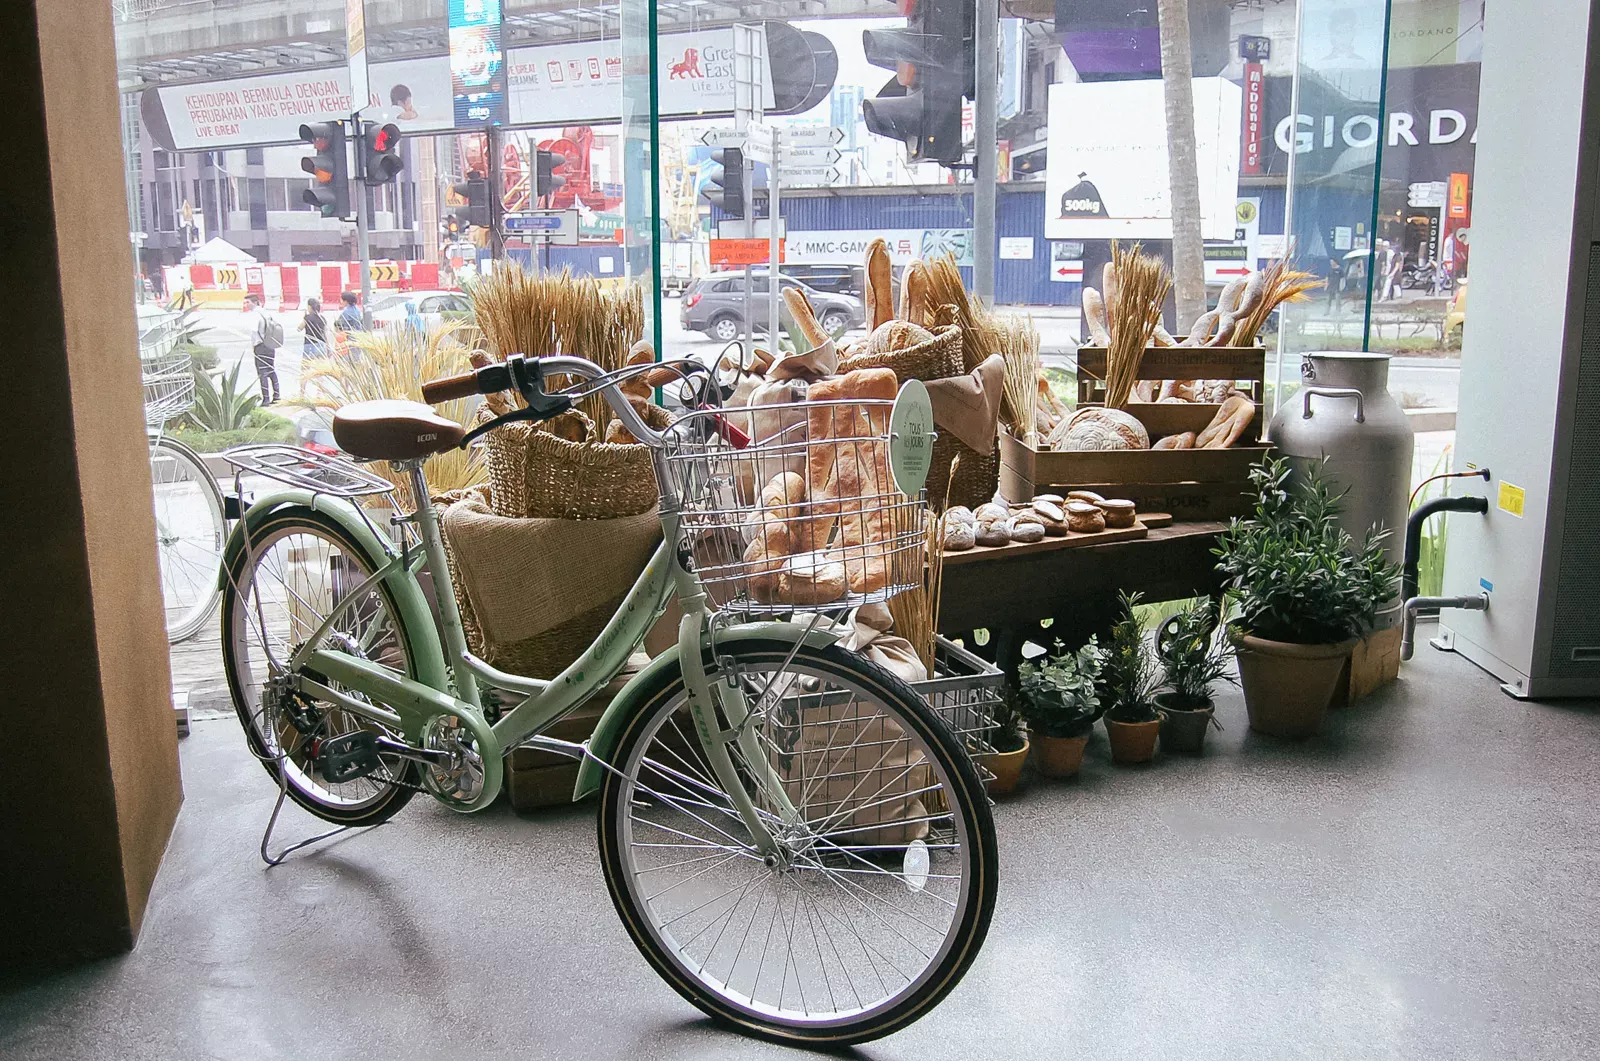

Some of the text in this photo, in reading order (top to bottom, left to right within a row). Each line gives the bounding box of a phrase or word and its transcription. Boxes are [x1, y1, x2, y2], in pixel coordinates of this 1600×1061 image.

[1392, 26, 1454, 39] IORDANO
[703, 45, 735, 62] Grea
[704, 62, 735, 78] East
[691, 80, 712, 92] Life
[716, 80, 725, 90] is
[185, 80, 340, 109] KEHIDUPAN BERMULA DENGAN
[190, 106, 249, 124] PERUBAHAN
[251, 102, 278, 119] YANG
[280, 100, 316, 116] PENUH
[1248, 70, 1260, 166] McDonald's
[195, 123, 241, 138] LIVE GREAT
[1064, 198, 1100, 213] 500kg
[806, 241, 894, 253] MMC-GAMA
[1428, 217, 1438, 263] GIORDAN
[909, 422, 921, 435] TOUS
[417, 433, 437, 443] ICON
[909, 436, 924, 451] JOURS
